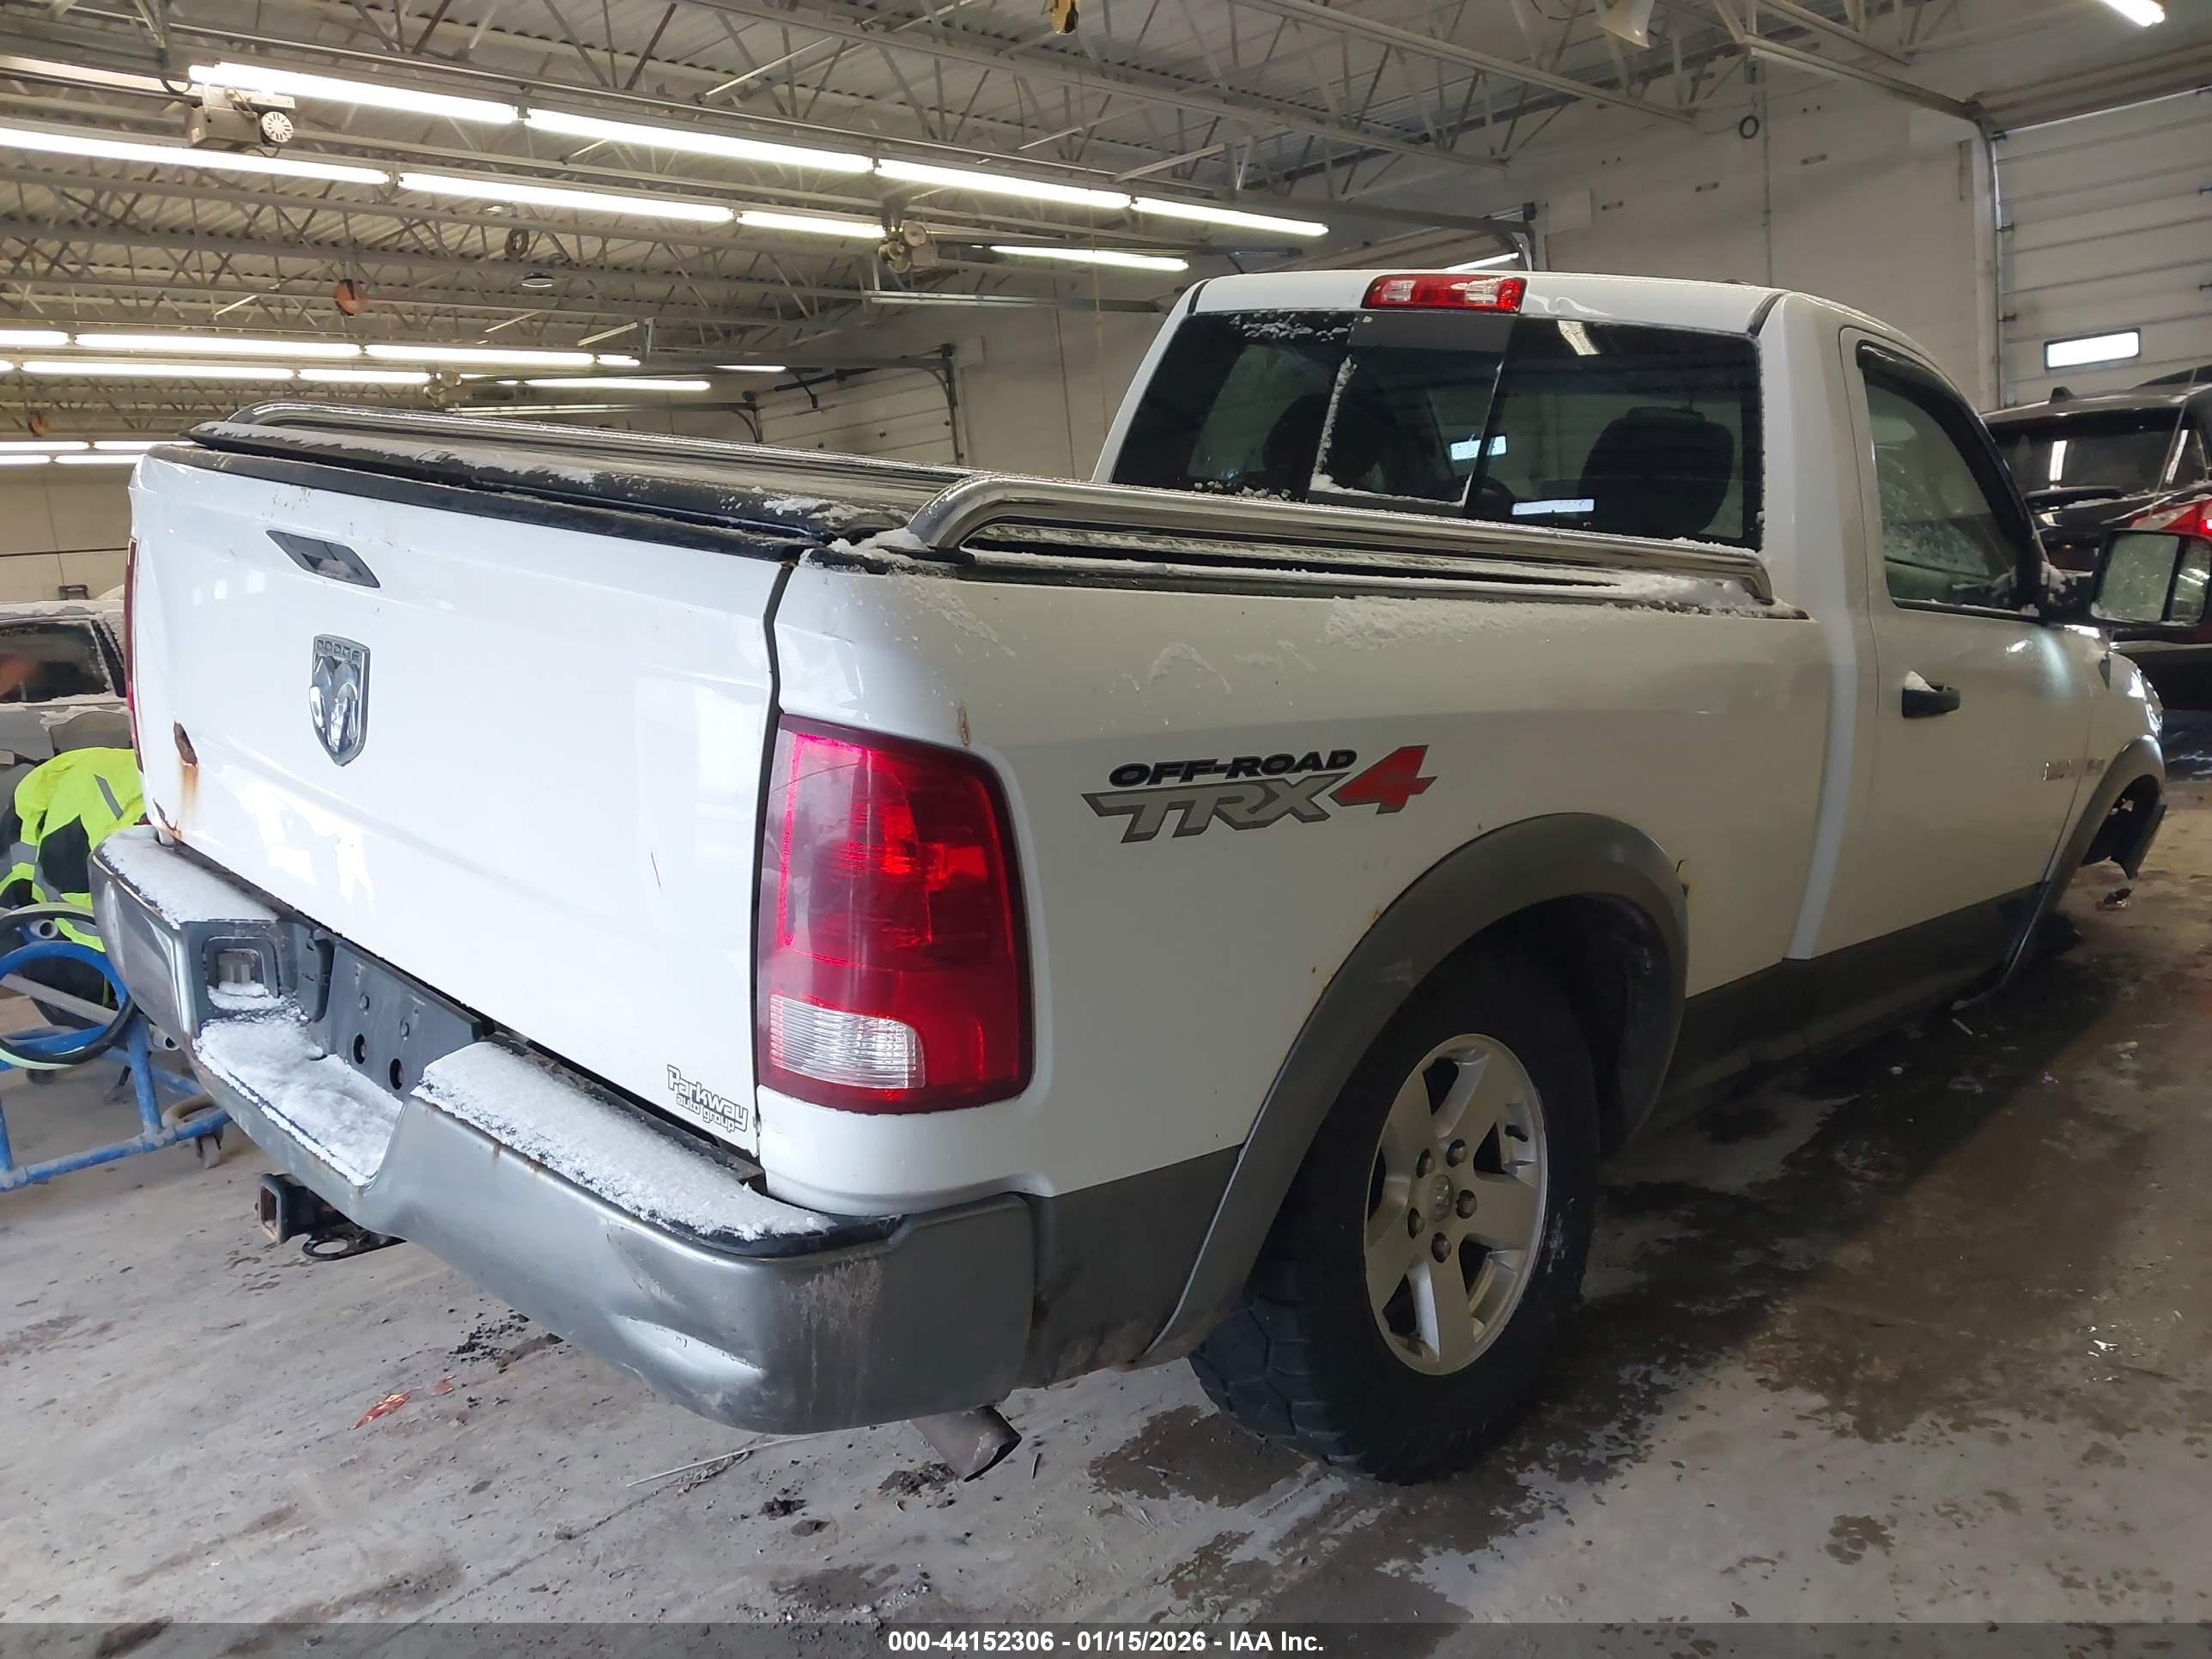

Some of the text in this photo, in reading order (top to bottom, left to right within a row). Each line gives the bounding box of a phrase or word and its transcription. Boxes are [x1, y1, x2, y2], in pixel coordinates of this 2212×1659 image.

[316, 639, 360, 660] DODGE
[1108, 749, 1358, 787] OFF-ROAD
[666, 1064, 749, 1133] Parkway
[675, 1093, 736, 1133] auto group
